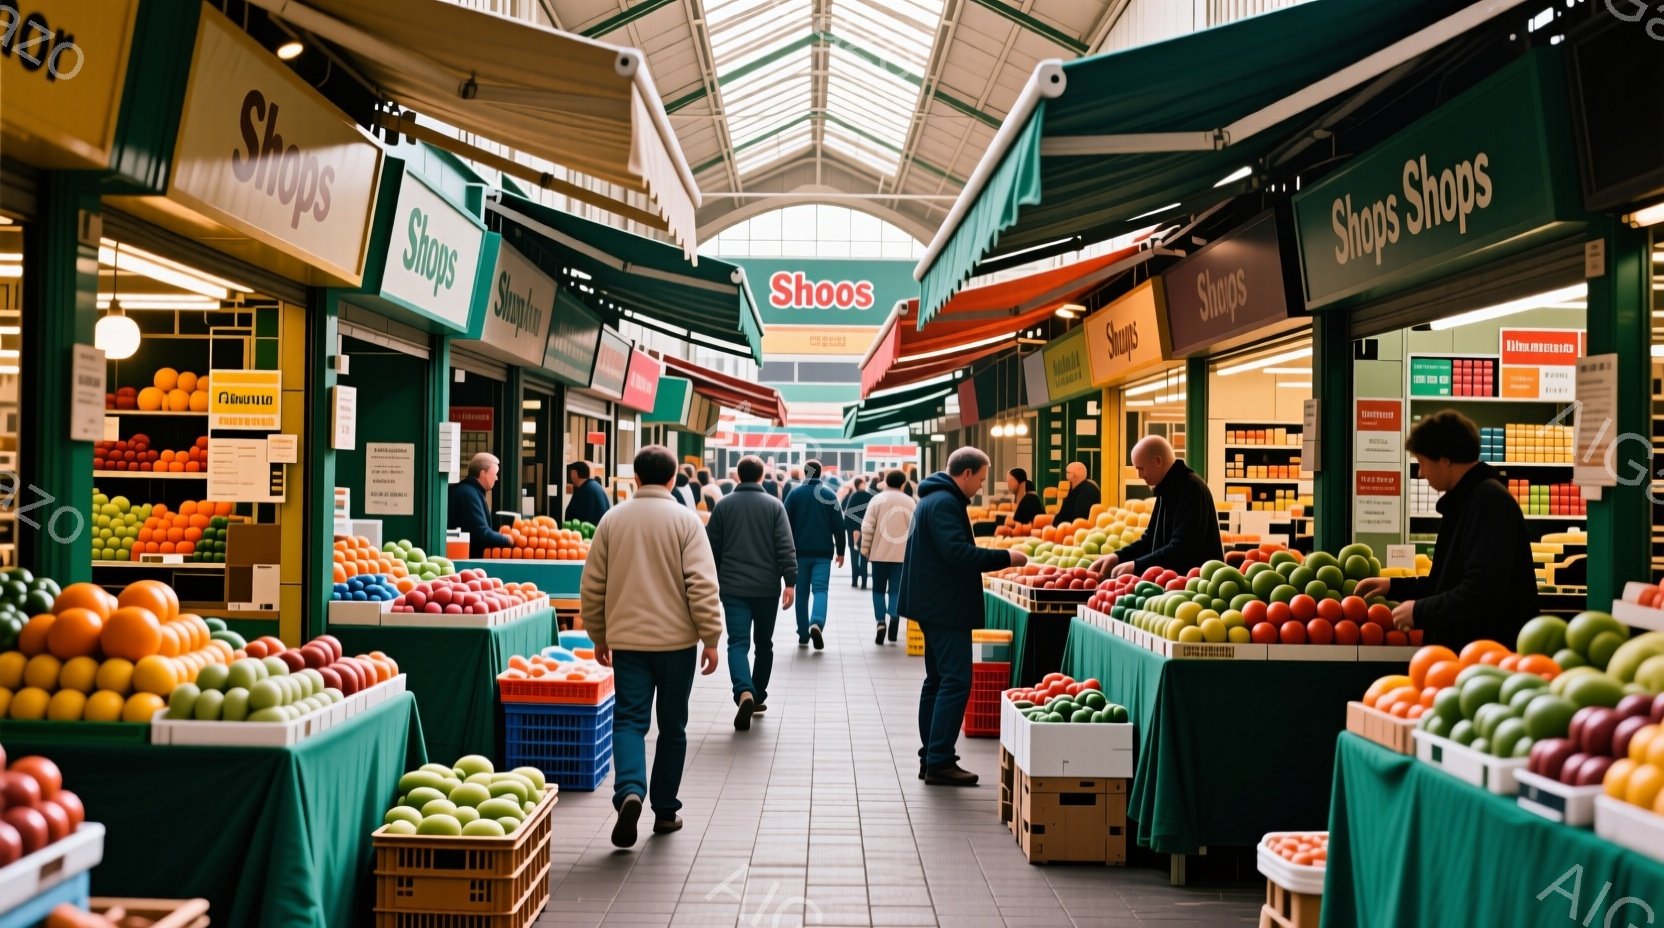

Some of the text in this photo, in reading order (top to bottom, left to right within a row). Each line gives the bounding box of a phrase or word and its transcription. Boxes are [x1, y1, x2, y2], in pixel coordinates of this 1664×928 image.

[232, 88, 335, 230] Shops
[1332, 151, 1493, 265] Shops Shops
[402, 207, 458, 298] Shops
[769, 271, 875, 310] Shoos
